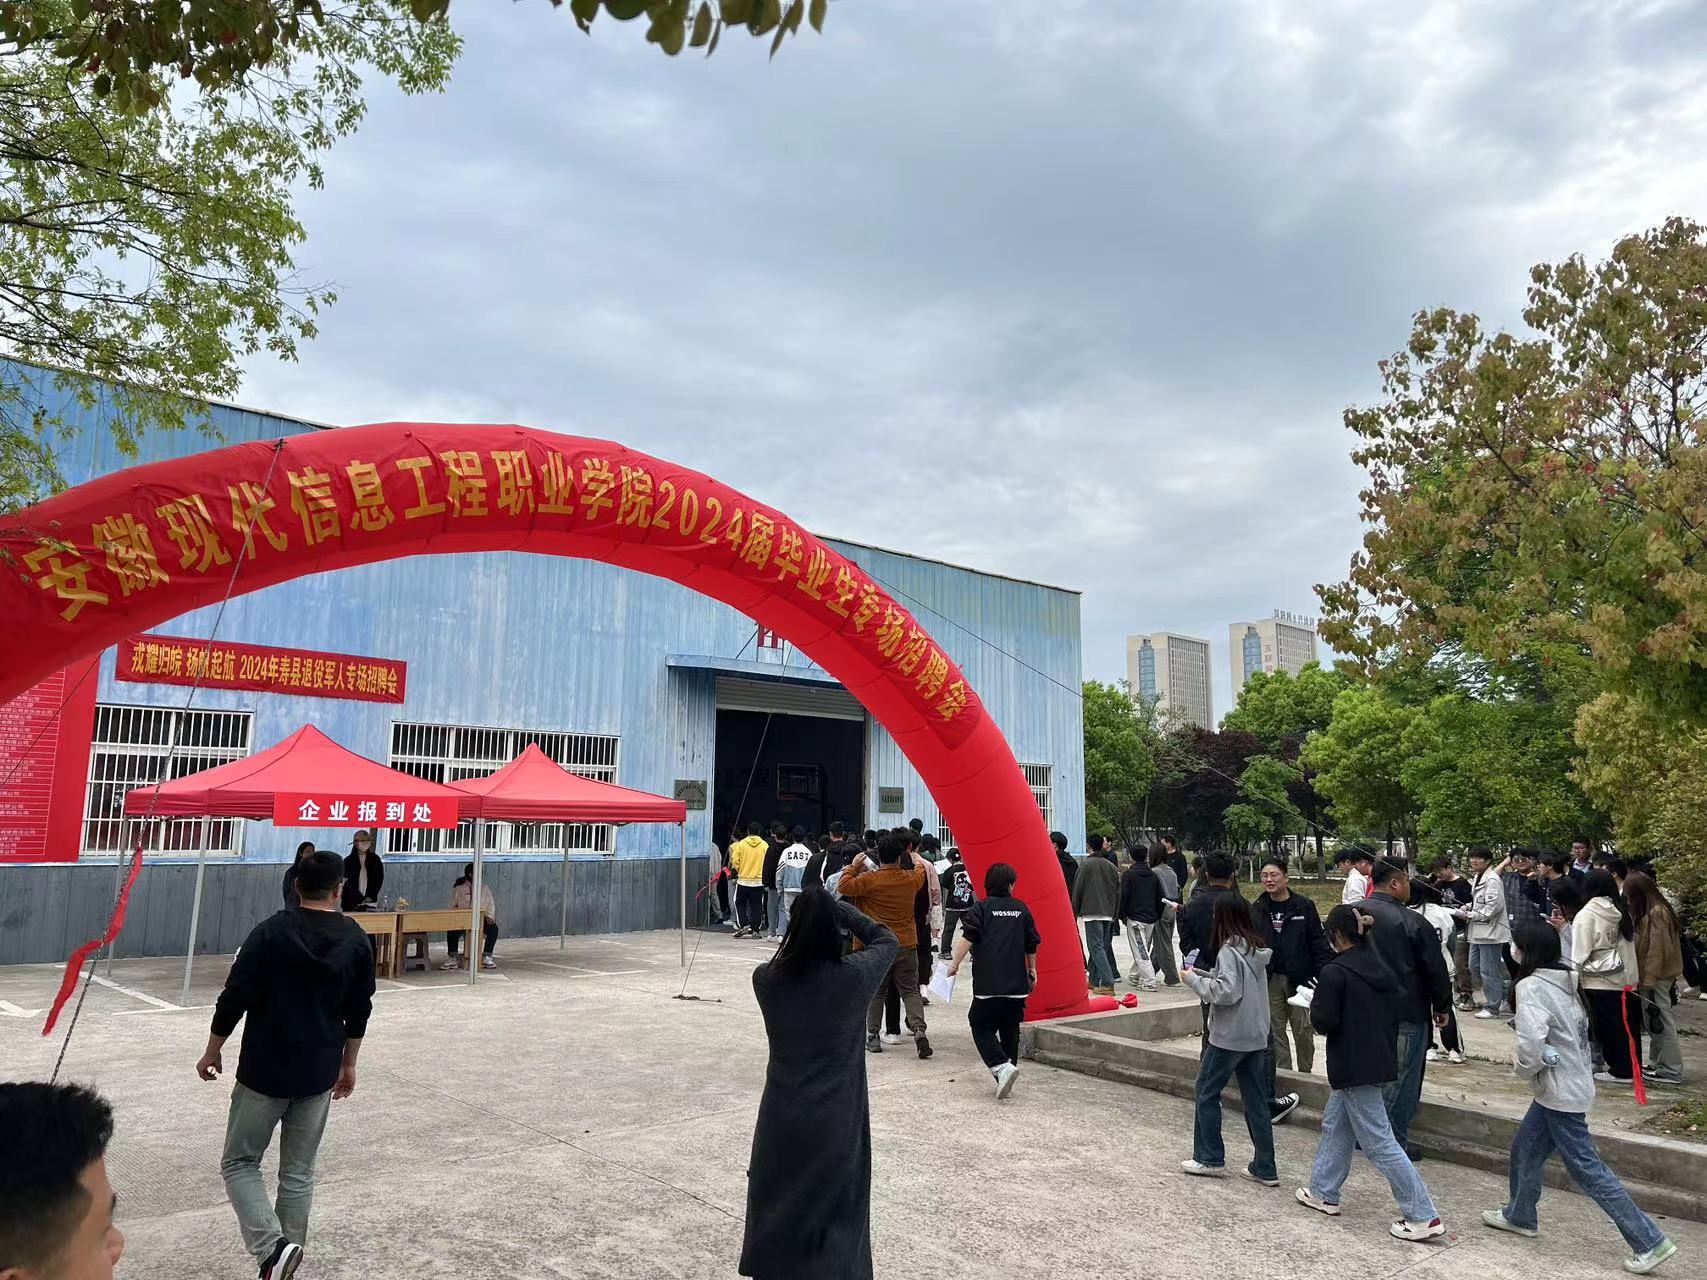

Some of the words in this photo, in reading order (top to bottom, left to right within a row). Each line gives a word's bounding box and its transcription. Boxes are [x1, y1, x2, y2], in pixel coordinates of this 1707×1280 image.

[22, 449, 970, 721] 安徽现代信息工程职业学院2024届毕业生专场招聘会
[131, 643, 182, 676] 戎耀归皖
[186, 647, 236, 681] 扬帆起航
[239, 654, 398, 695] 2024年寿县退役军人专场招聘会
[298, 799, 432, 823] 企业报到处
